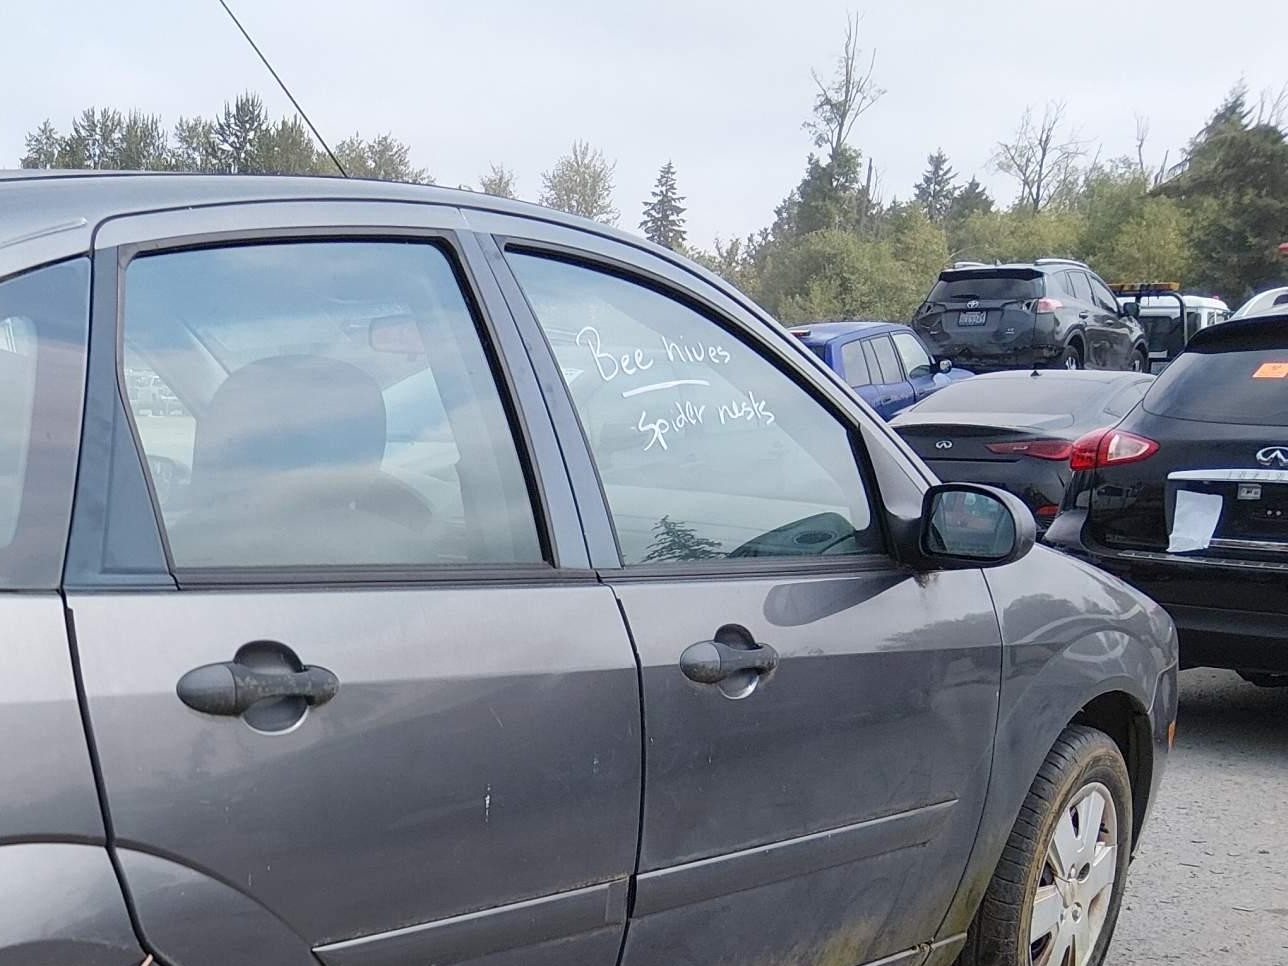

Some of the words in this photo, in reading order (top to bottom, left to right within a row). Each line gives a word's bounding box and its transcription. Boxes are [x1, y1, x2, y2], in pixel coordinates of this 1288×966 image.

[575, 325, 655, 383] Bee
[661, 335, 731, 365] hives
[636, 401, 707, 452] Spider
[717, 390, 776, 425] nests
